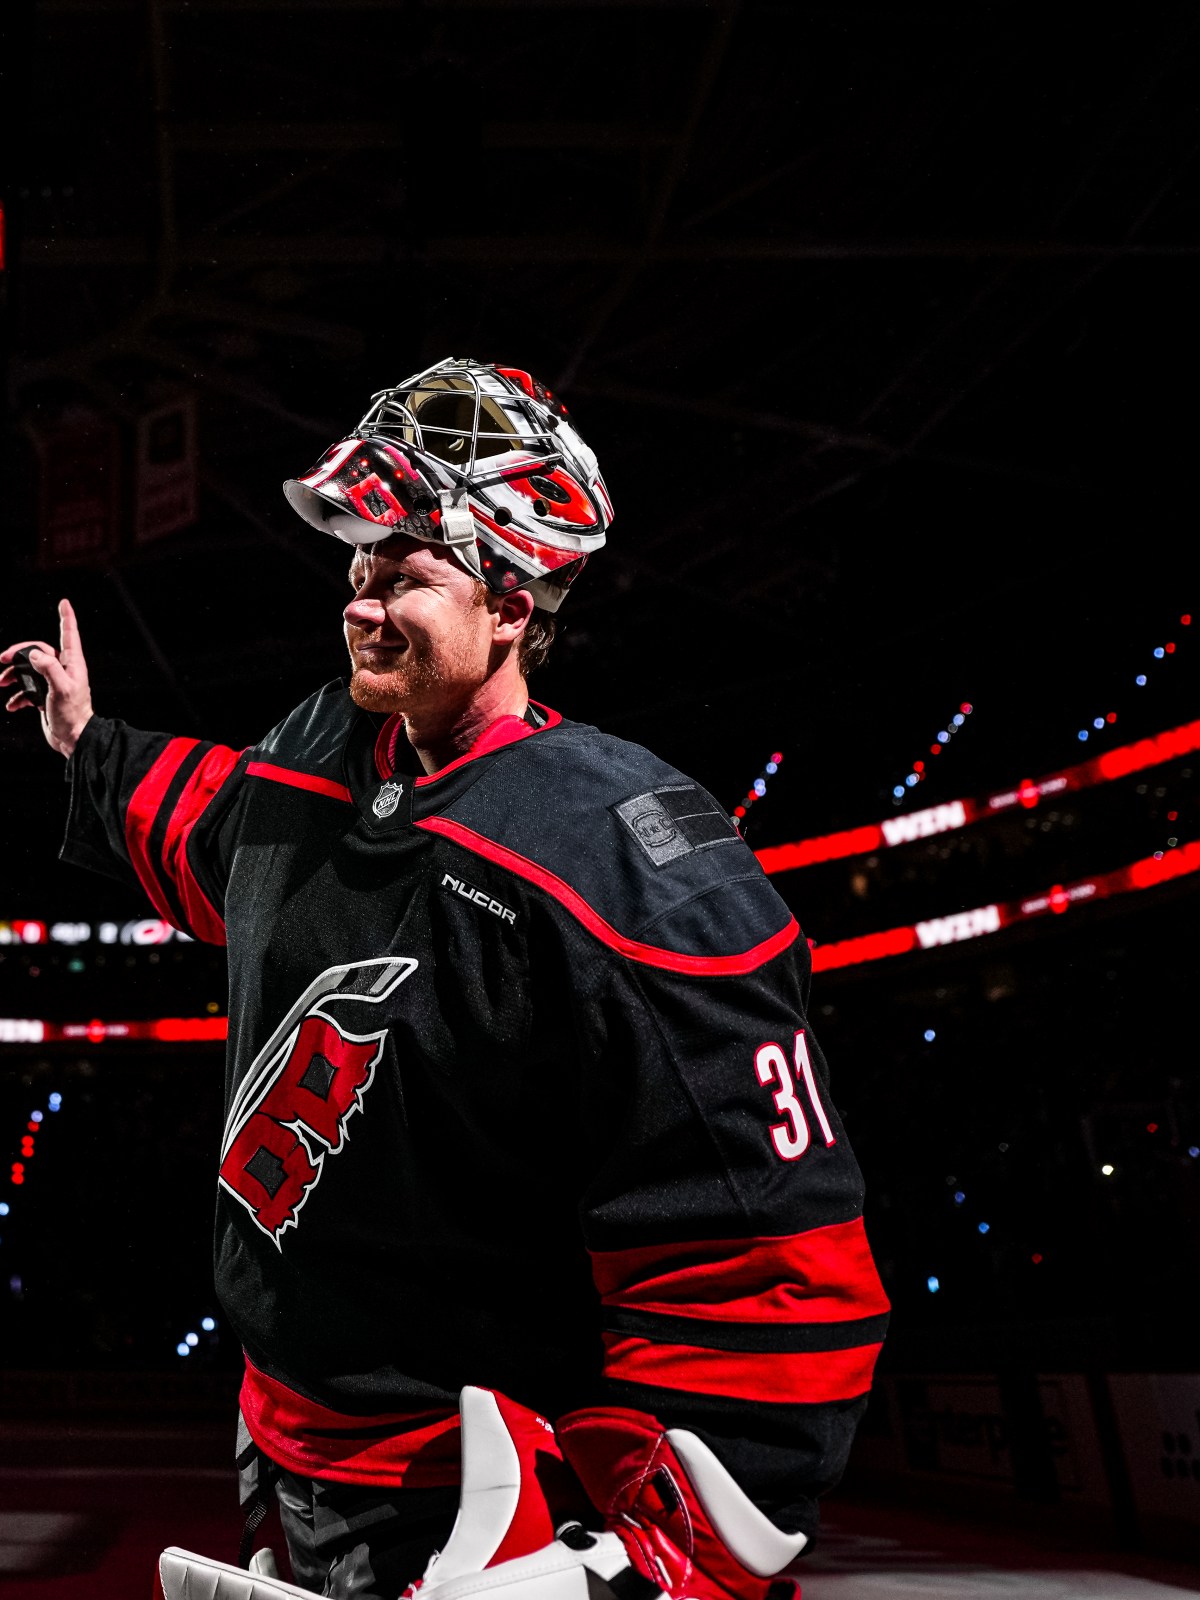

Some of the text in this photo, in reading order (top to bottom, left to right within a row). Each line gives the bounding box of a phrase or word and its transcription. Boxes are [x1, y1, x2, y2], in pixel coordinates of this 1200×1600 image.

[881, 799, 966, 846] WIN
[441, 873, 517, 925] NUCOR
[915, 905, 1000, 949] WIN
[753, 1028, 837, 1162] 31
